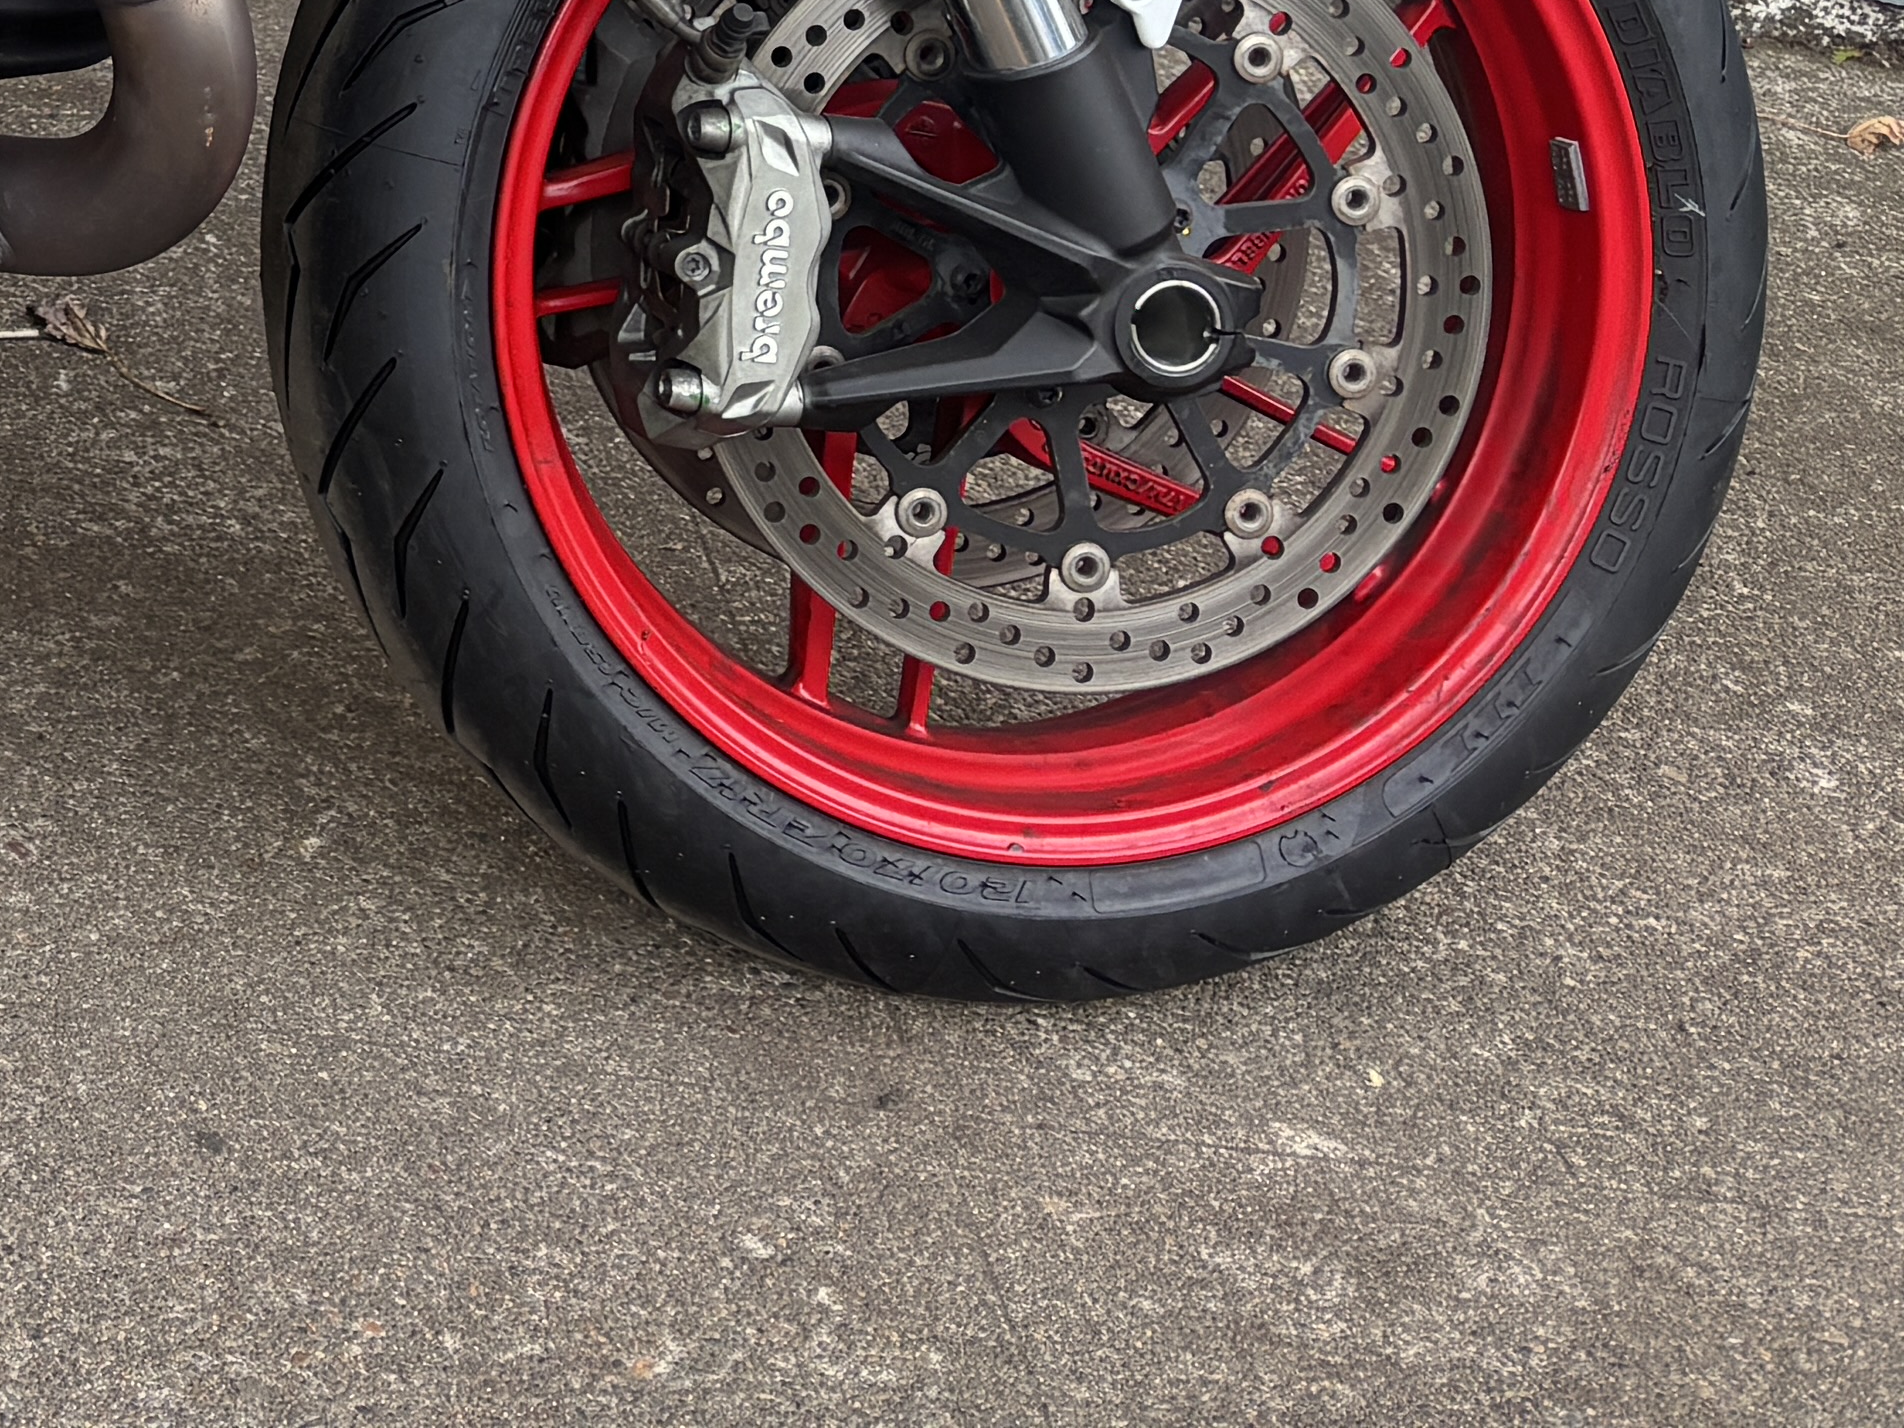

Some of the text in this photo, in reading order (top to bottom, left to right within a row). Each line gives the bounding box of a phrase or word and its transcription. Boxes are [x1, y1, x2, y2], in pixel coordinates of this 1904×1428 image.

[1606, 0, 1696, 260] DIABLO
[739, 187, 795, 365] brembo
[1586, 356, 1688, 575] ROSSO
